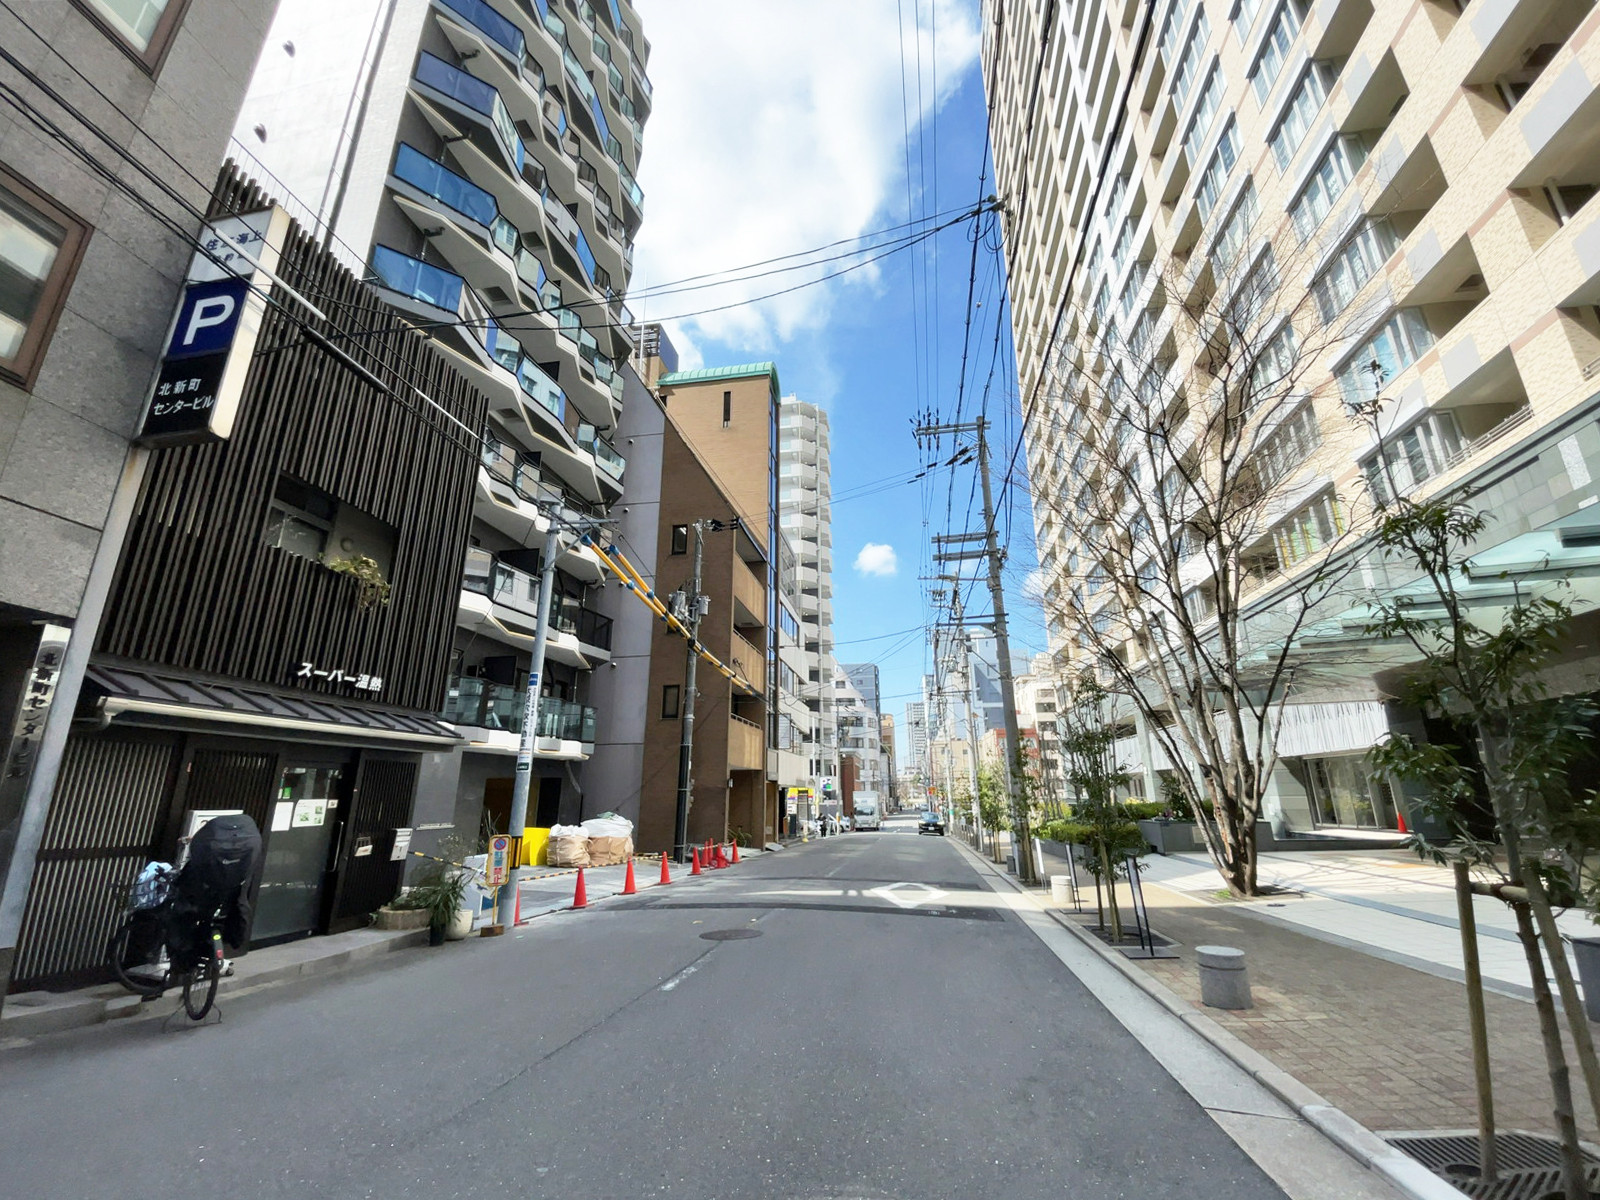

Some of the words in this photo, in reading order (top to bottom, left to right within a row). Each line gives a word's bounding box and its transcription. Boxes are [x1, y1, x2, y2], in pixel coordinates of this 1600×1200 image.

[183, 295, 235, 346] P
[158, 378, 202, 396] 北新町
[154, 395, 214, 415] センタービル
